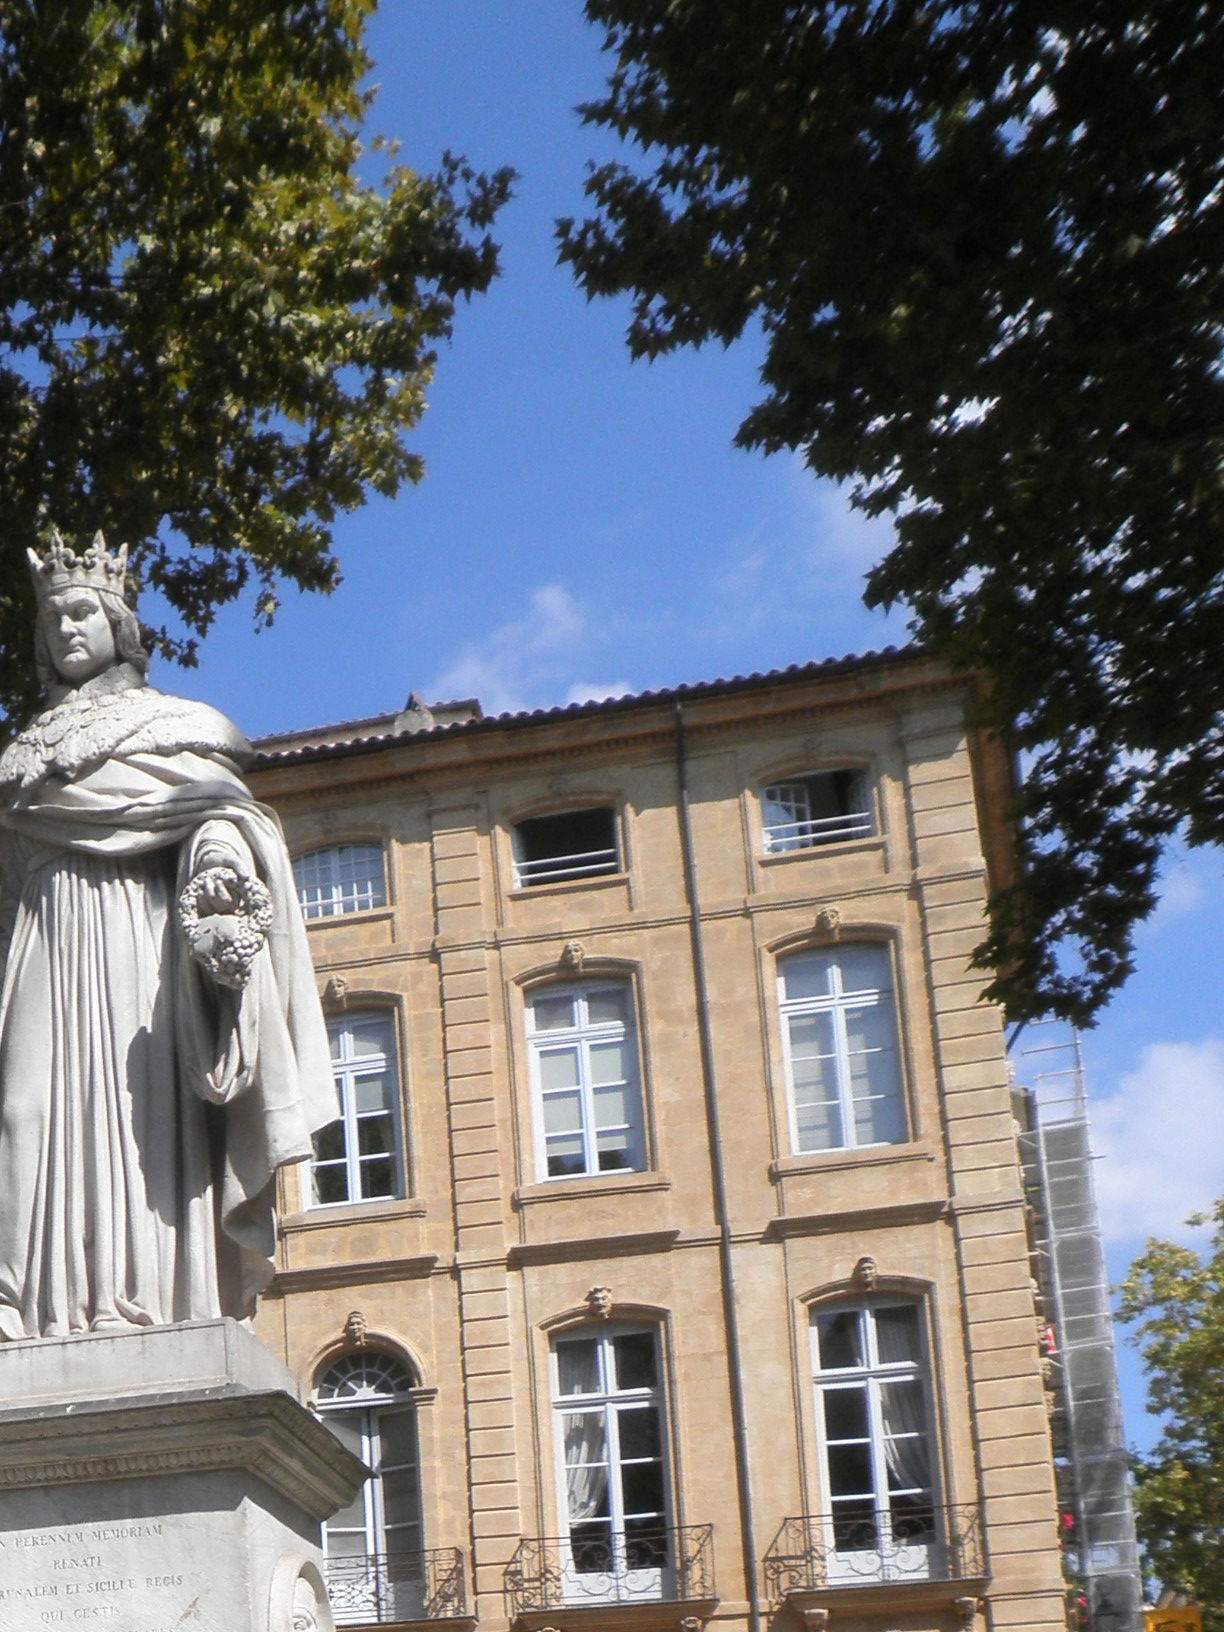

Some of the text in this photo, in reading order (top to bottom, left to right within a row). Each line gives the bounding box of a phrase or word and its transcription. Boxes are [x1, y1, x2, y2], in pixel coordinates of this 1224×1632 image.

[92, 1524, 163, 1541] MEMORIAM
[52, 1556, 103, 1571] RENATI
[66, 1583, 81, 1595] ET
[146, 1574, 184, 1587] REGIS
[40, 1610, 64, 1623] QUI
